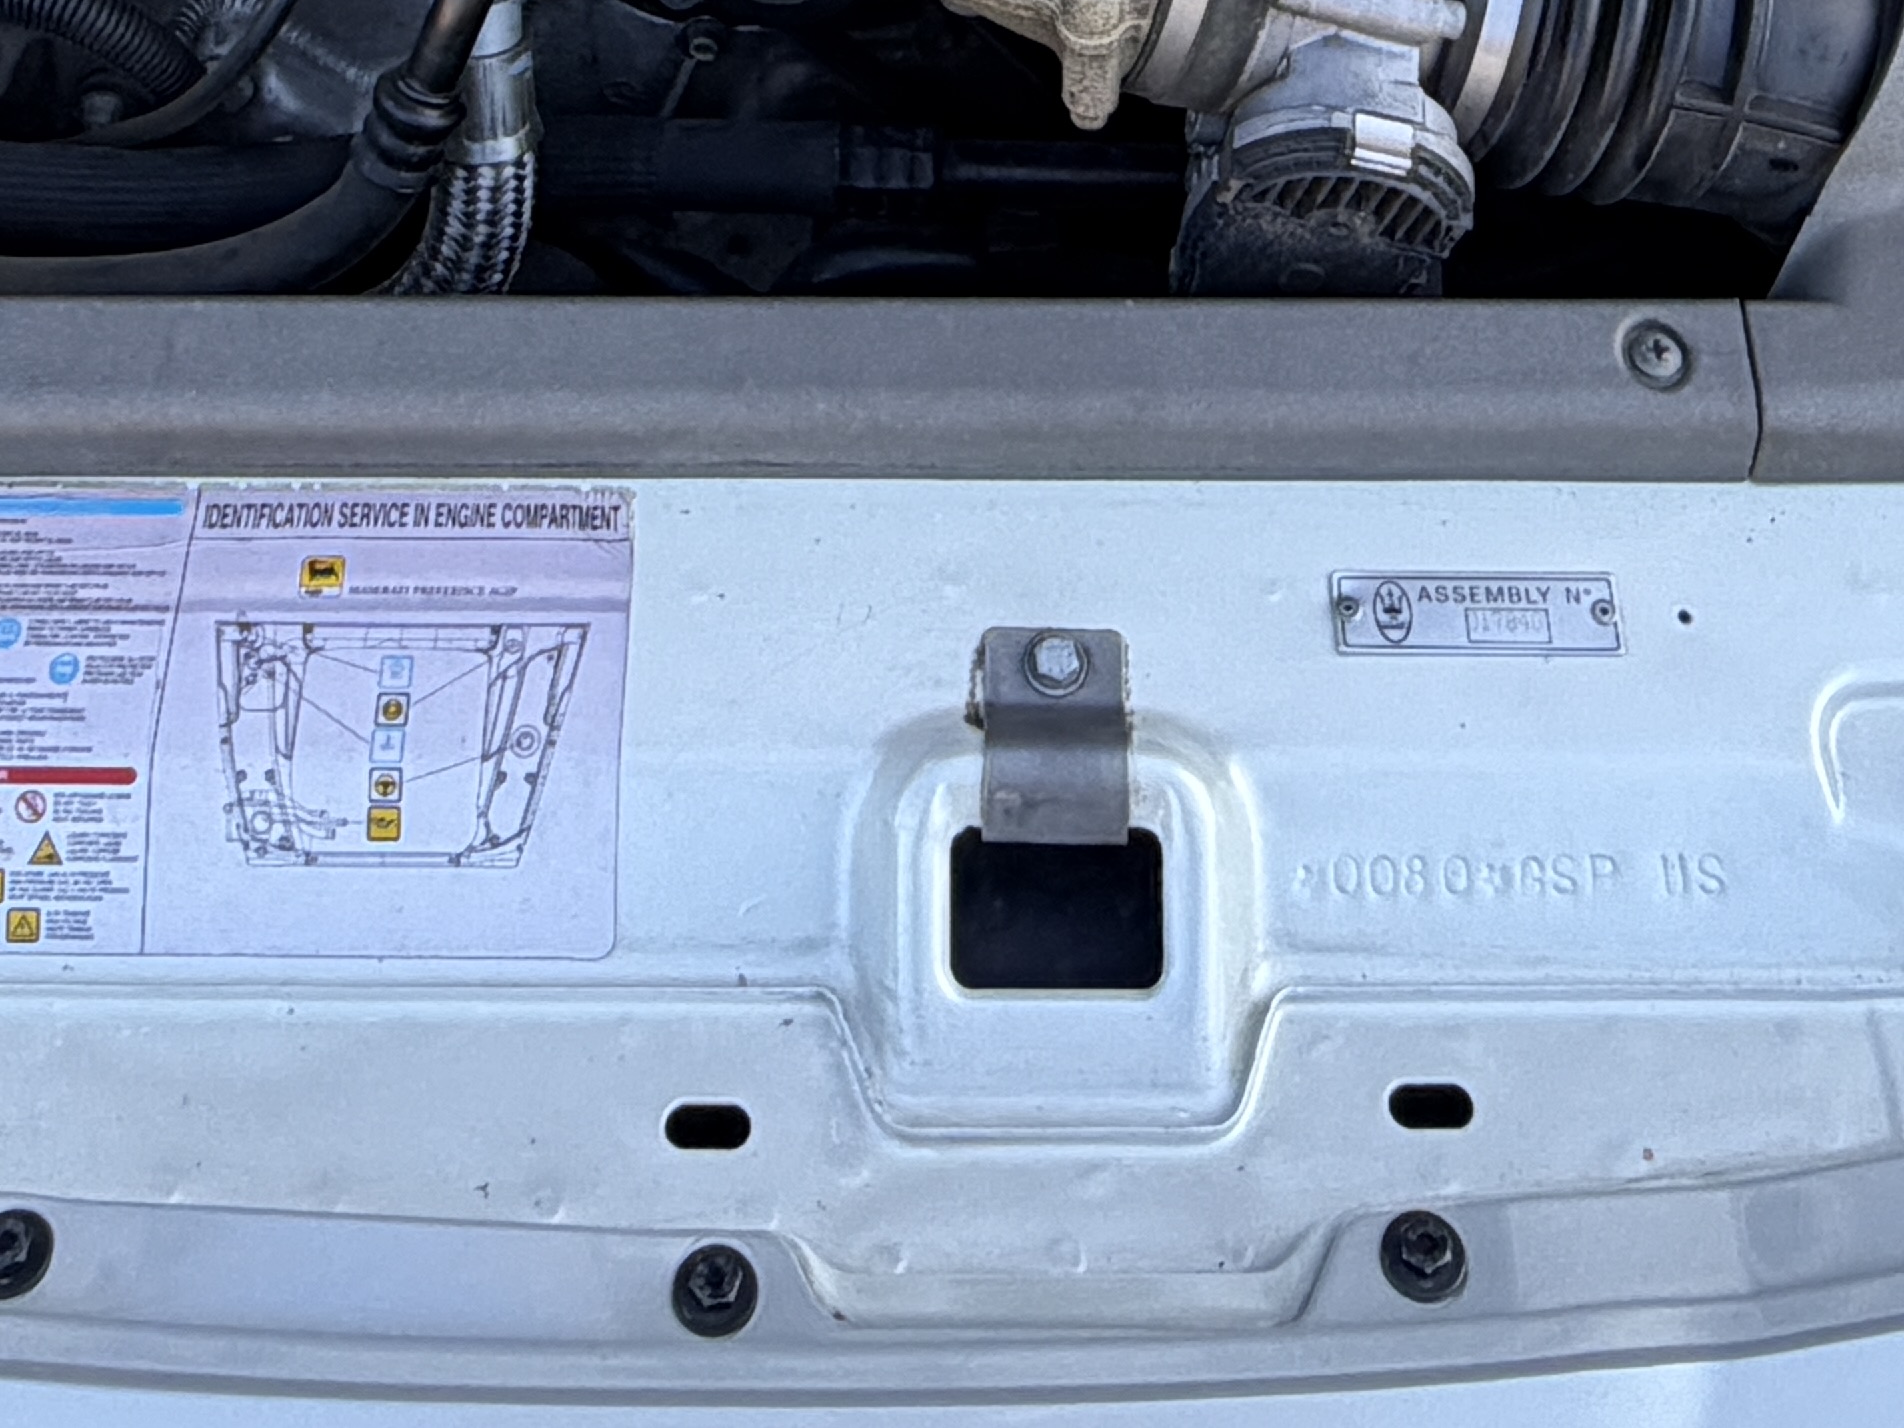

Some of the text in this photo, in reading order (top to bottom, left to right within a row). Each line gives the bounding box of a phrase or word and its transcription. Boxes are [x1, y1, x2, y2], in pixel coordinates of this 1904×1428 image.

[202, 501, 623, 533] IDENTIFICATION SERVICE IN ENGINE COMPARTMENT
[1417, 585, 1552, 605] ASSEMBLY
